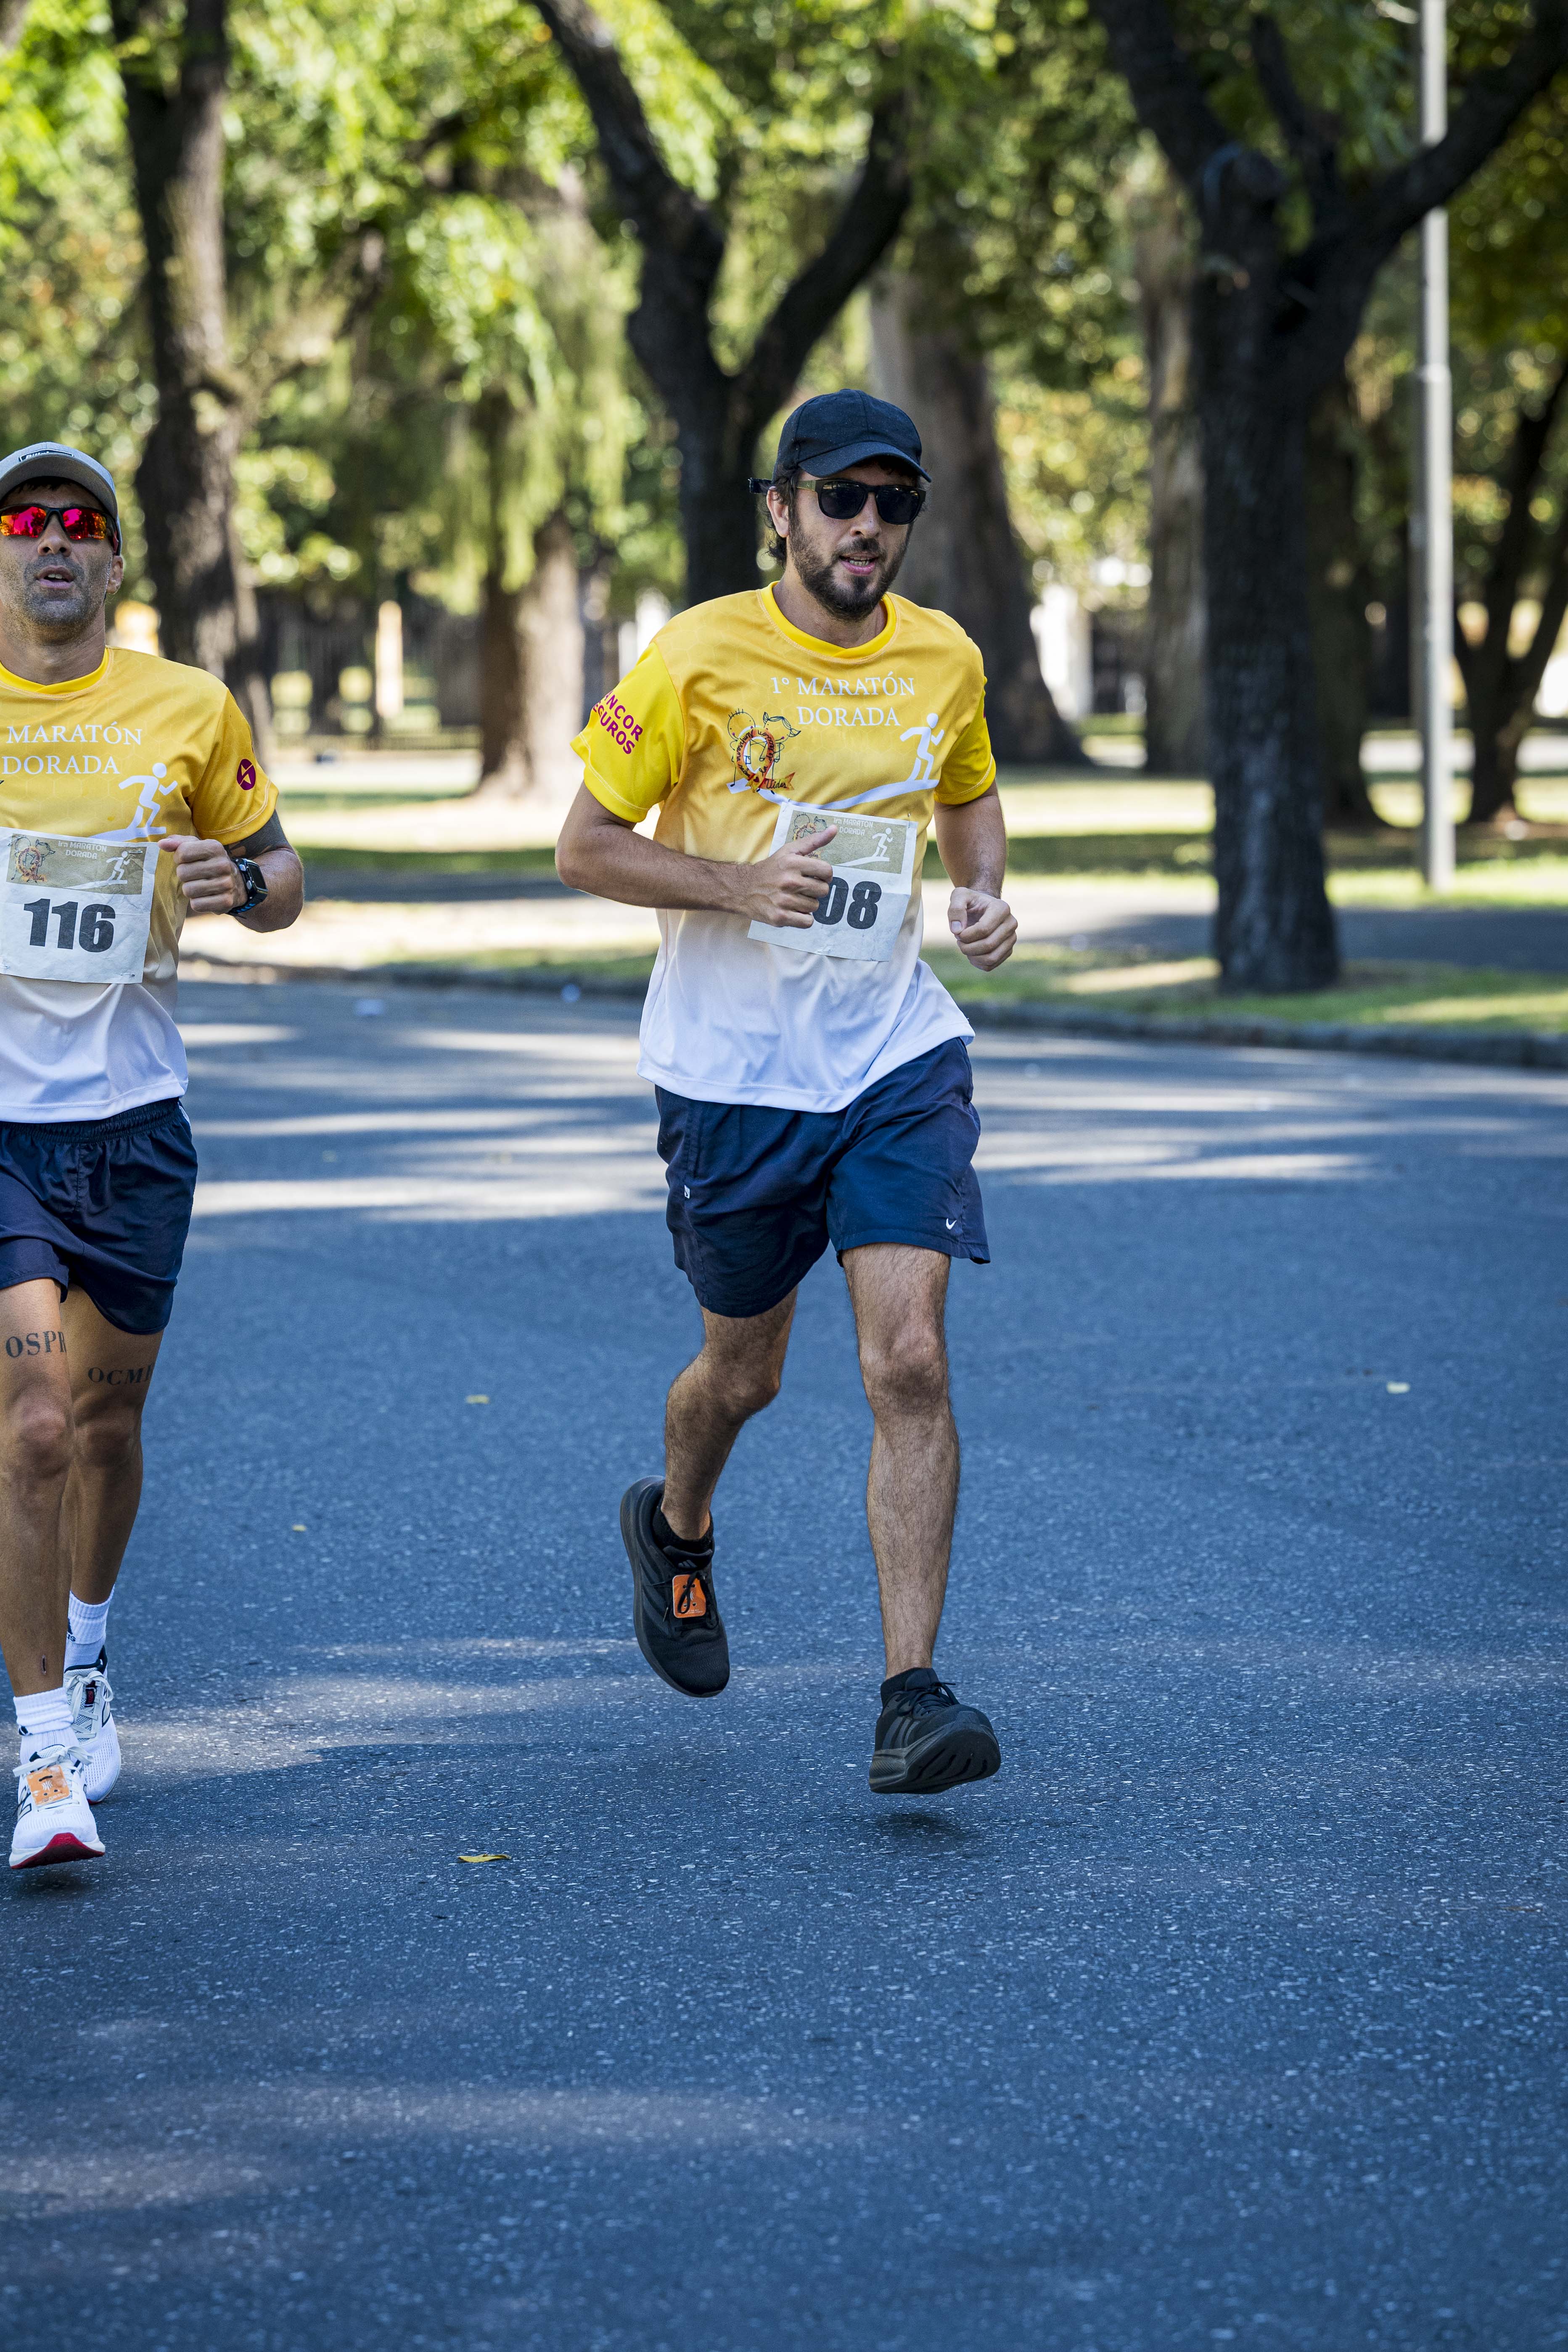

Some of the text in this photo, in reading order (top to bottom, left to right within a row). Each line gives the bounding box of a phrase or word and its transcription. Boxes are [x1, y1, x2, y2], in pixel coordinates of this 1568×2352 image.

[796, 671, 915, 695] MARATÓN
[797, 707, 900, 726] DORADA
[6, 722, 143, 745] MARATÓN
[2, 755, 120, 774] DORADA
[839, 827, 865, 836] DORADA
[65, 849, 98, 859] DORADA
[24, 898, 116, 952] 116
